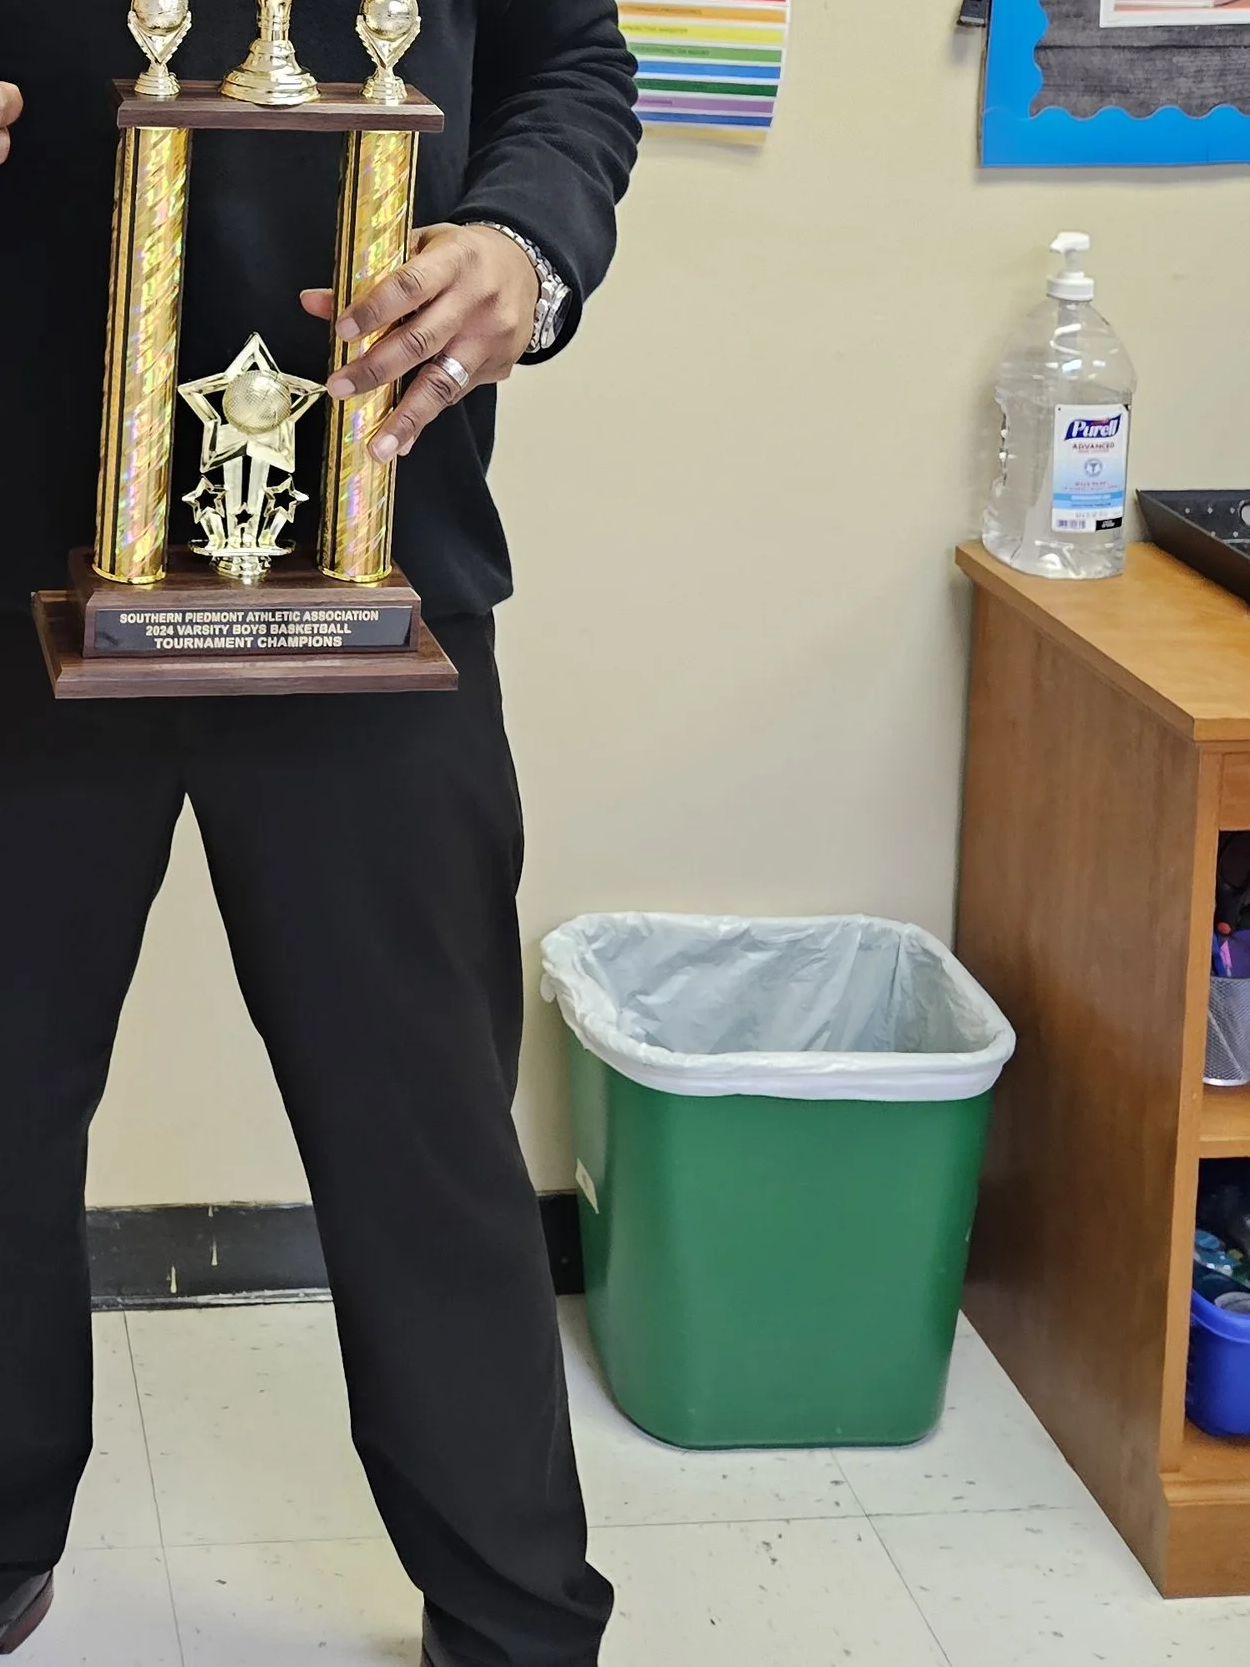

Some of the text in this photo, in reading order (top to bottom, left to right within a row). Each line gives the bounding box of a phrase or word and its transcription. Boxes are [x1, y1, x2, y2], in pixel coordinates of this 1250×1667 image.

[119, 610, 379, 624] SOUTHERN PIEDMONT ATHLETIC ASSOCIATION
[145, 623, 352, 636] 2024 VARSITY BOYS BASKETBALL
[154, 635, 343, 649] TOURNAMENT CHAMPIONS
